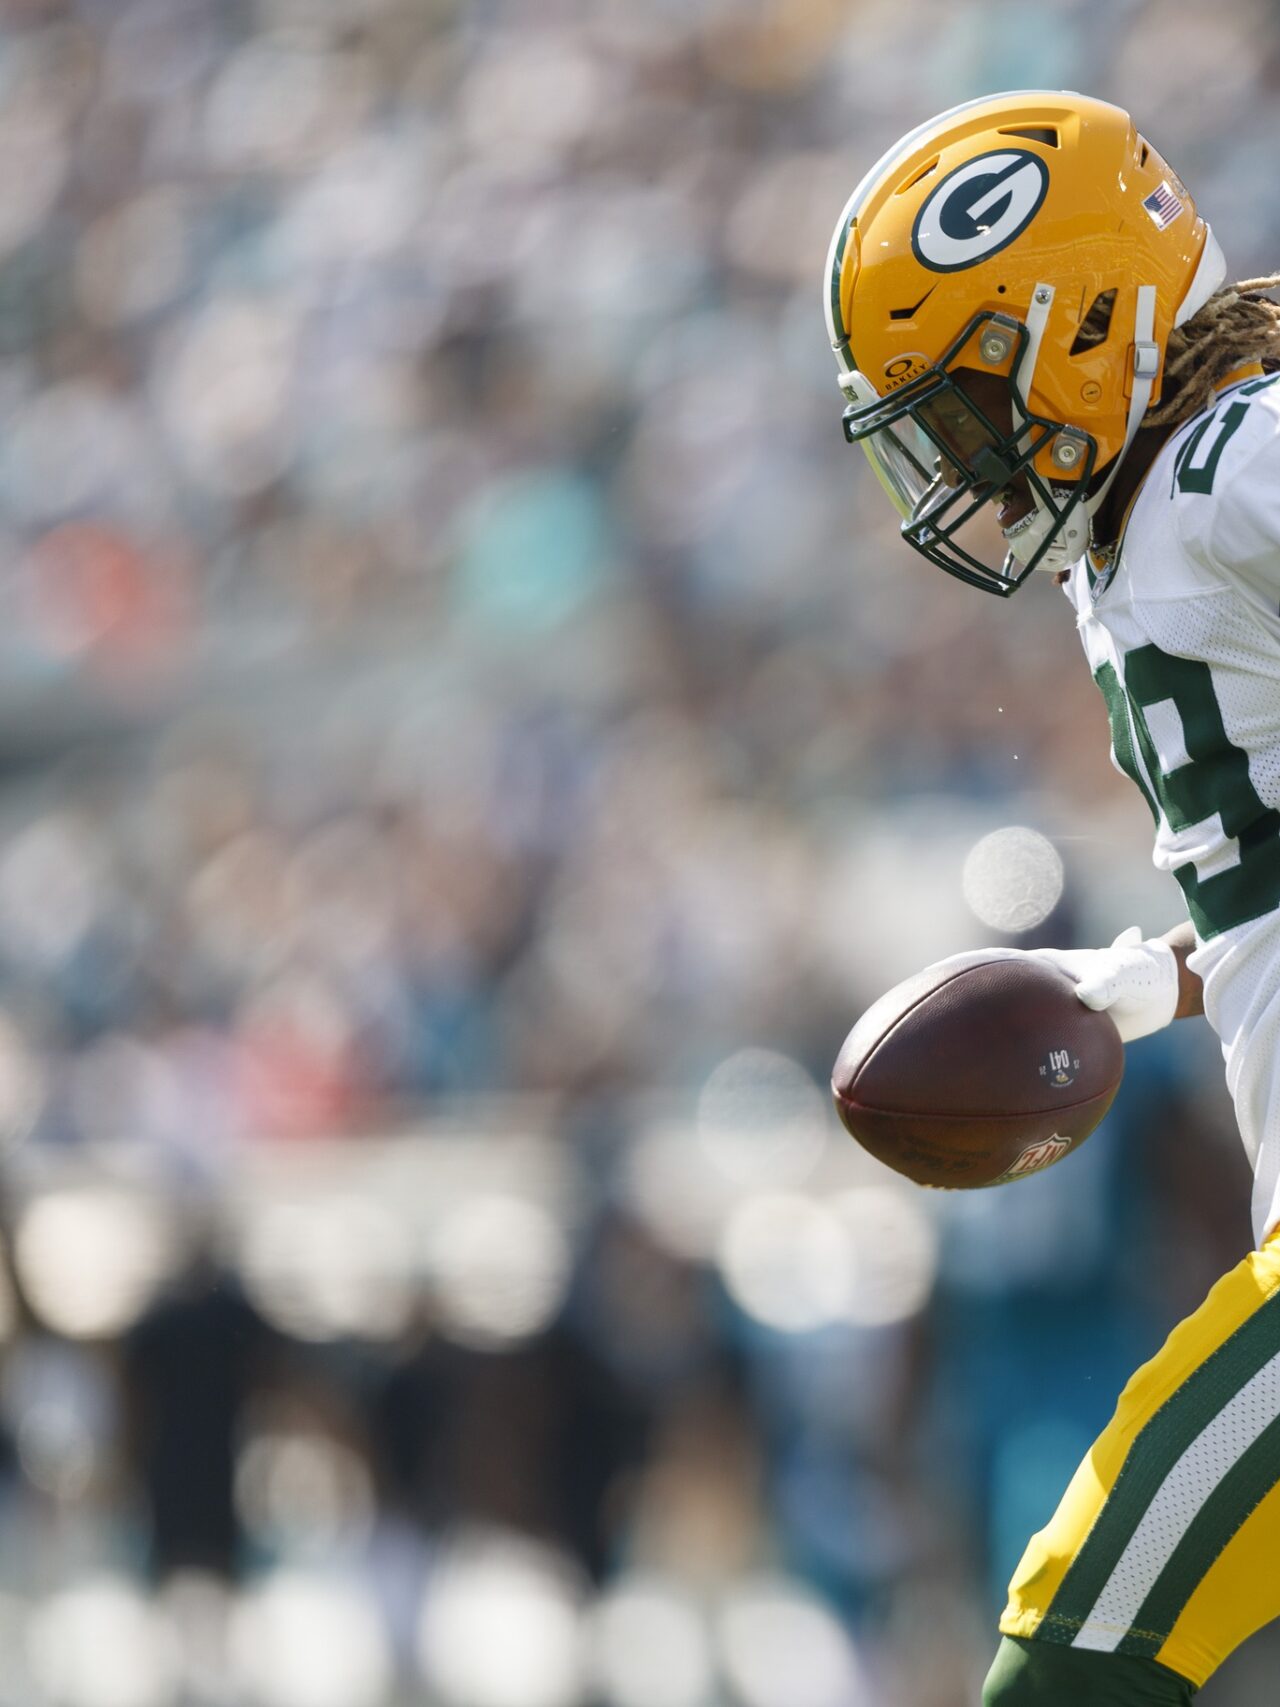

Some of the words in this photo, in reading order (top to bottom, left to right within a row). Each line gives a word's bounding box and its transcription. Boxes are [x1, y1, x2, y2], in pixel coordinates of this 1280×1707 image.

[917, 153, 1043, 266] G
[885, 362, 927, 391] OAKLEY
[1049, 1049, 1070, 1071] 041
[1015, 1144, 1065, 1173] NFL
